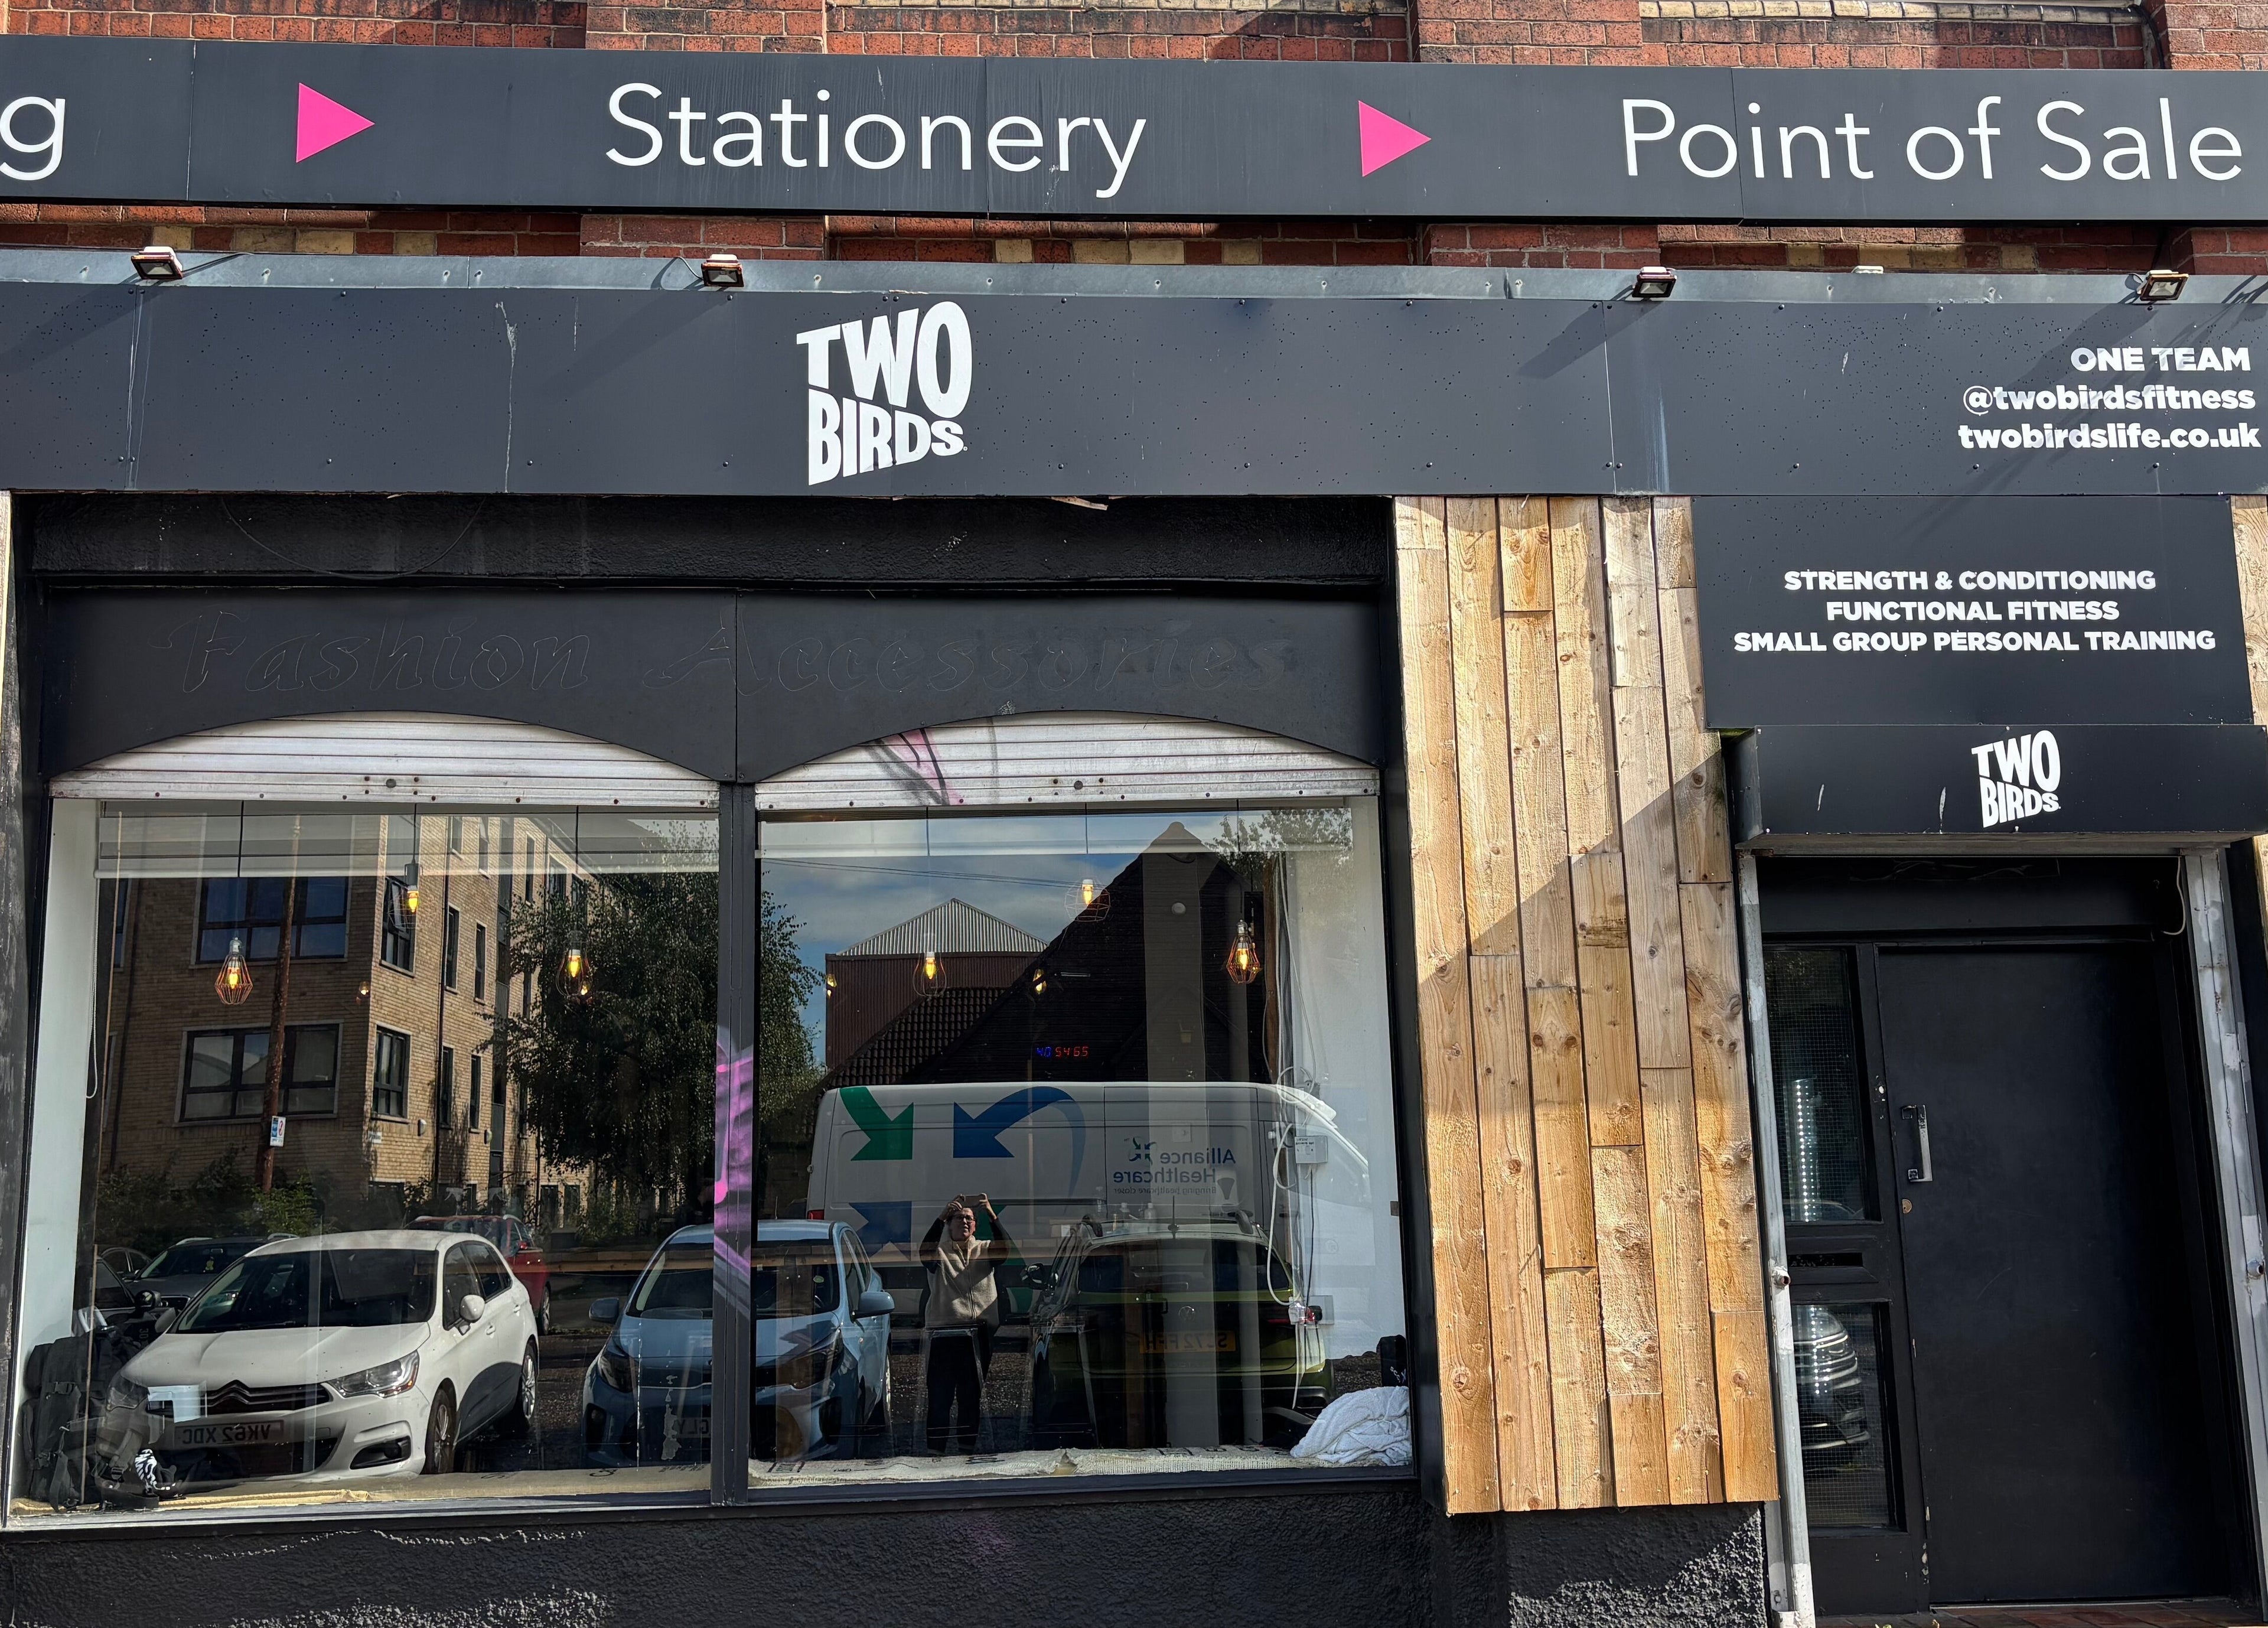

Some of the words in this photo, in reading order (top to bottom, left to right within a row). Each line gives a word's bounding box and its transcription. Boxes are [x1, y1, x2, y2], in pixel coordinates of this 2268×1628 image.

[605, 82, 1146, 198] Stationery
[1622, 99, 1874, 180] Point
[1906, 96, 2002, 180] of
[2036, 97, 2242, 181] Sale
[796, 301, 972, 418] TWO
[2070, 347, 2145, 372] ONE
[2151, 347, 2251, 372] TEAM
[1963, 384, 2256, 416] @twobirdsfitness
[808, 389, 965, 486] BIRDS
[1958, 422, 2262, 449] twobirdslife.co.uk
[1784, 570, 1928, 590] STRENGTH
[1934, 571, 1953, 590] &
[1959, 570, 2156, 590] CONDITIONING
[1826, 601, 2002, 621] FUNCTIONAL
[2008, 601, 2119, 620] FITNESS
[147, 610, 589, 692] Fashion
[642, 604, 1292, 693] Accessories
[1734, 632, 1827, 652] SMALL
[1833, 632, 1927, 652] GROUP
[1933, 631, 2080, 651] PERSONAL
[2084, 630, 2216, 650] TRAINING
[1971, 730, 2061, 792] TWO
[1979, 776, 2060, 828] BIRDS
